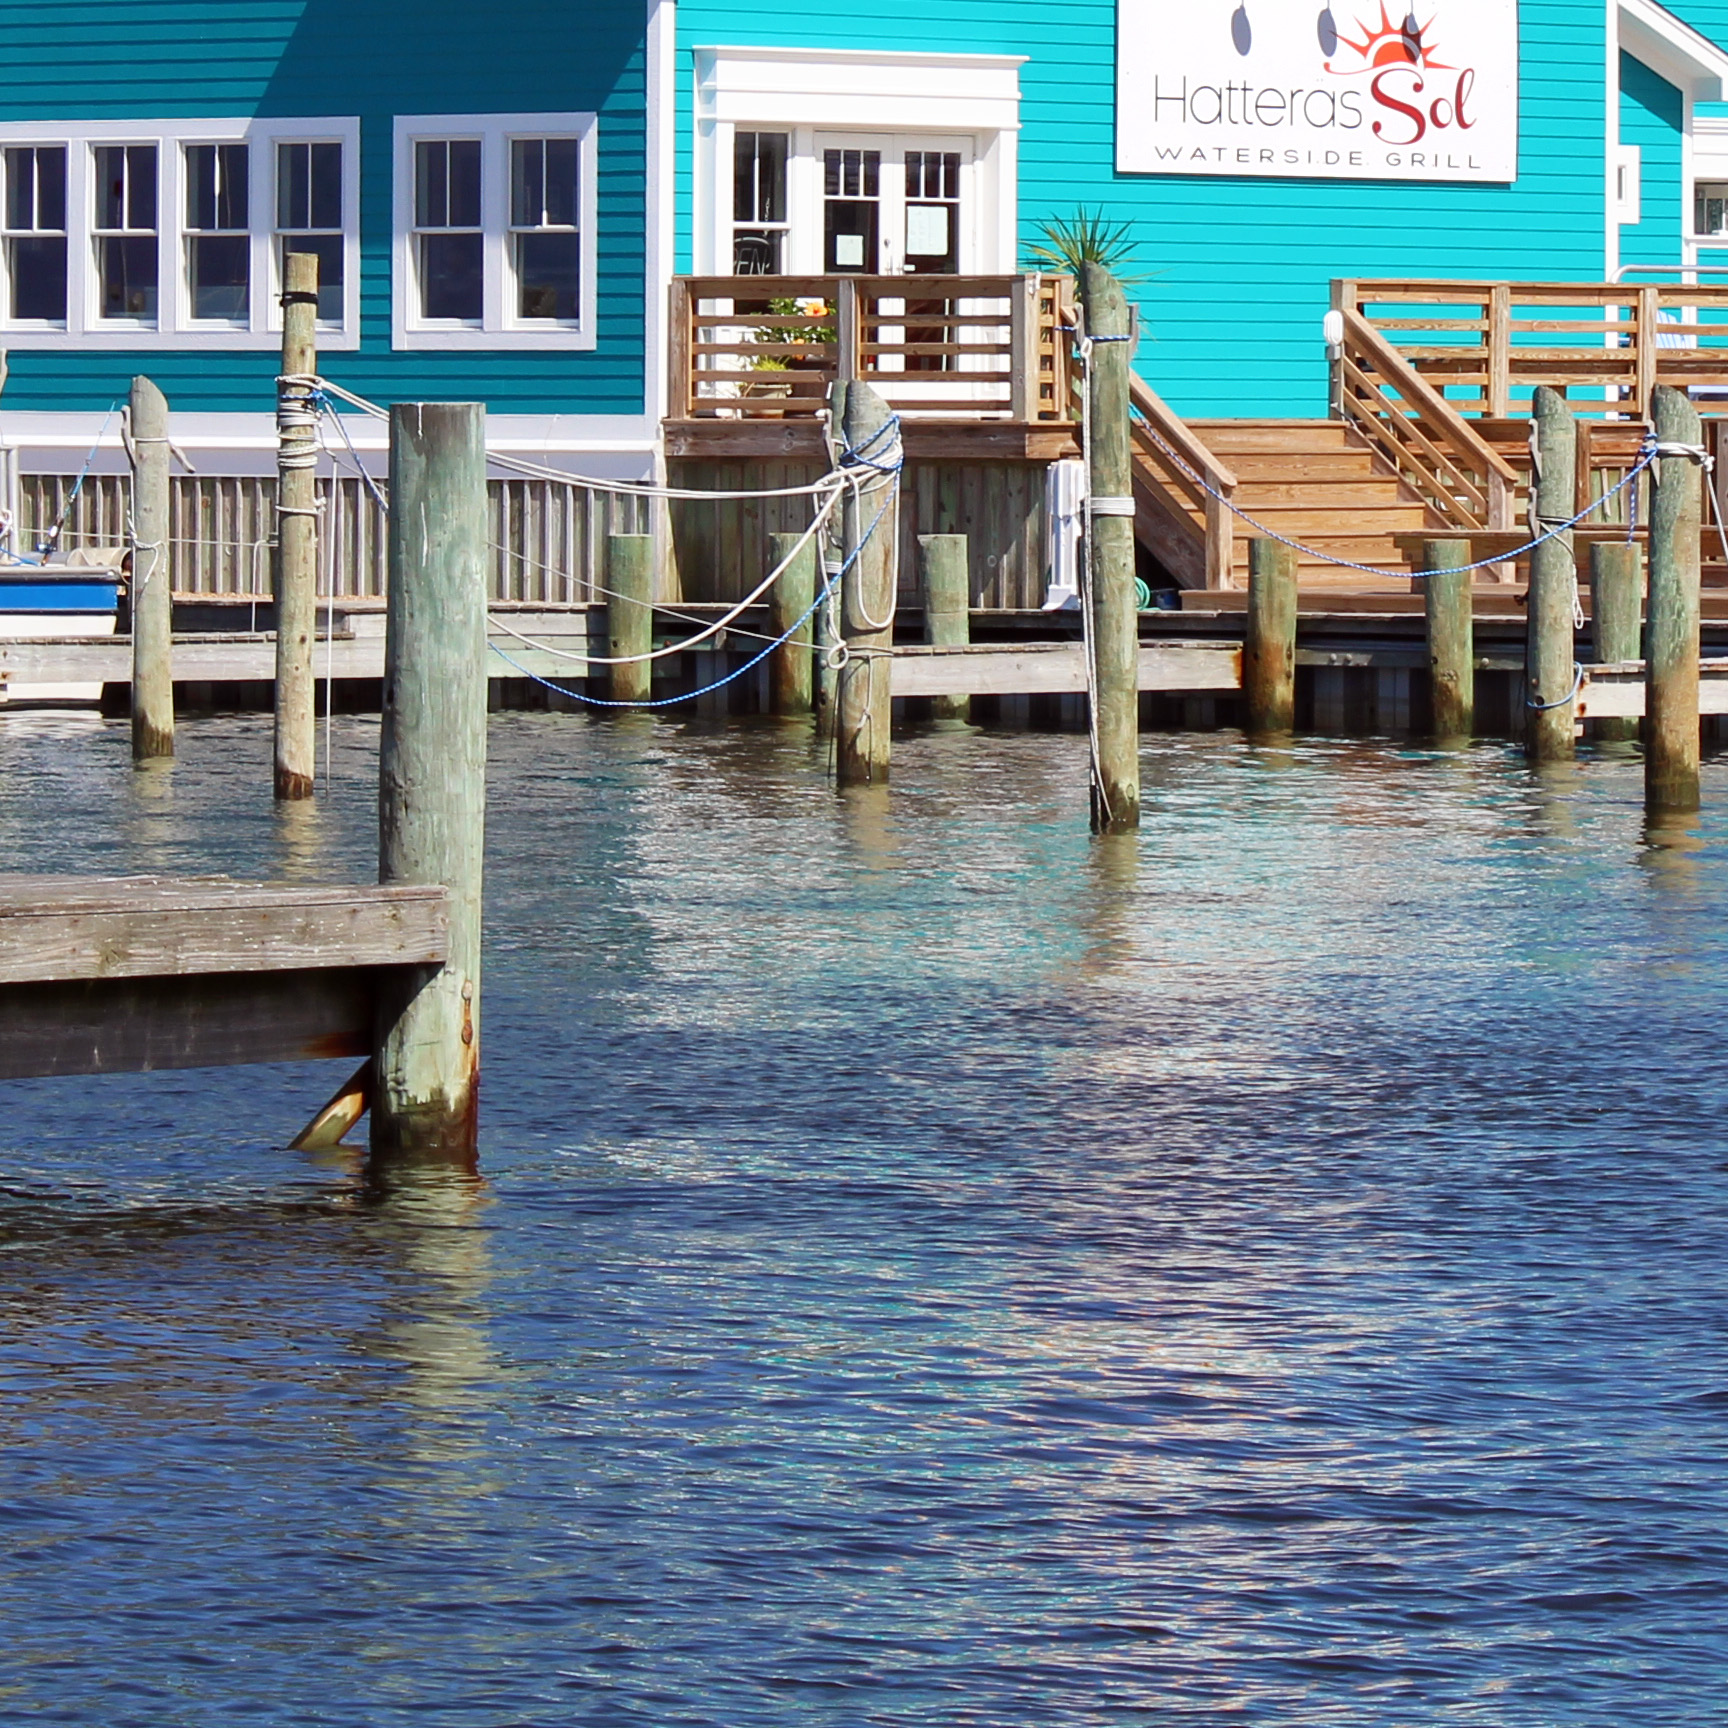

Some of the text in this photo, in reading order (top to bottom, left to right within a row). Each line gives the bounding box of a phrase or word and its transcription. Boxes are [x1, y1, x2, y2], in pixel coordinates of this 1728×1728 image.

[1154, 67, 1478, 146] Hatteras Sol
[1154, 145, 1482, 170] WATERSIDE GRILL
